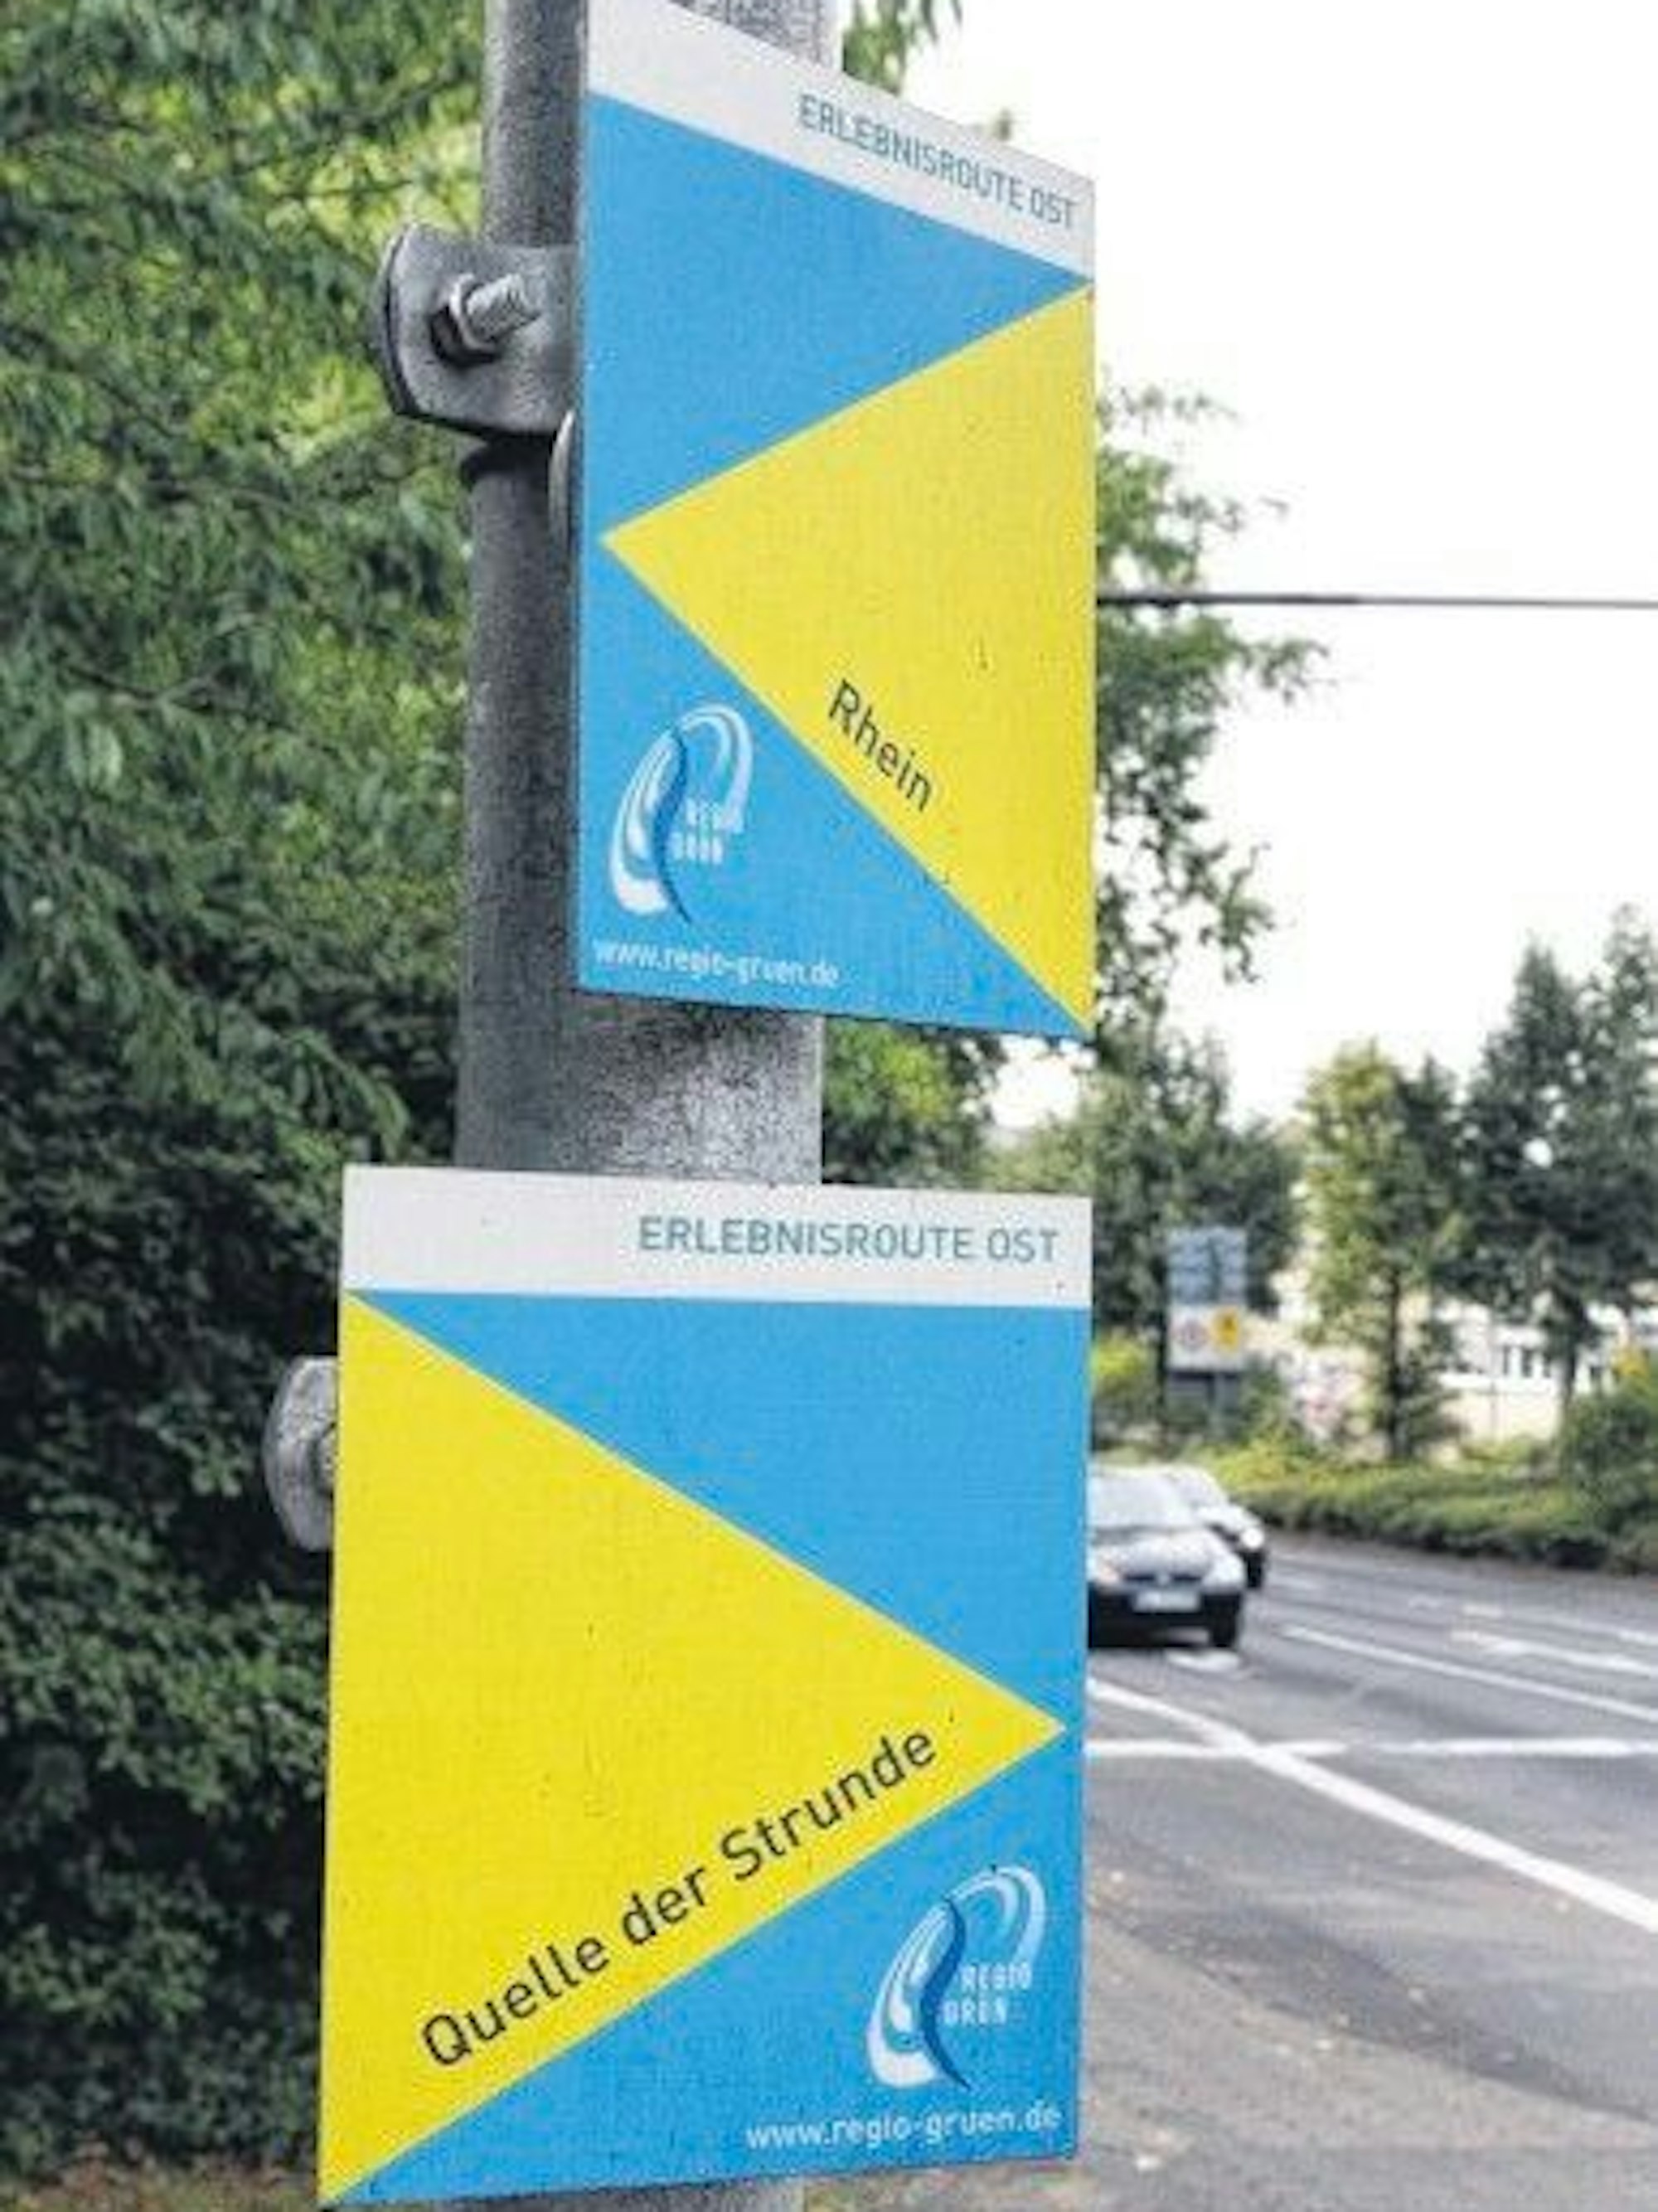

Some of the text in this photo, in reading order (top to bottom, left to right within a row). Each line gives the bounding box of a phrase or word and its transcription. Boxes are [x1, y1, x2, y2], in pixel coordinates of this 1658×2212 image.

[799, 94, 1077, 229] ERLEBNISROUTE OST
[829, 679, 933, 811] Rhein
[638, 1216, 1059, 1263] ERLEBNISROUTE OST
[419, 1729, 936, 2066] Quelle der Strunde
[746, 2100, 1061, 2148] www.regio-gruen.de
